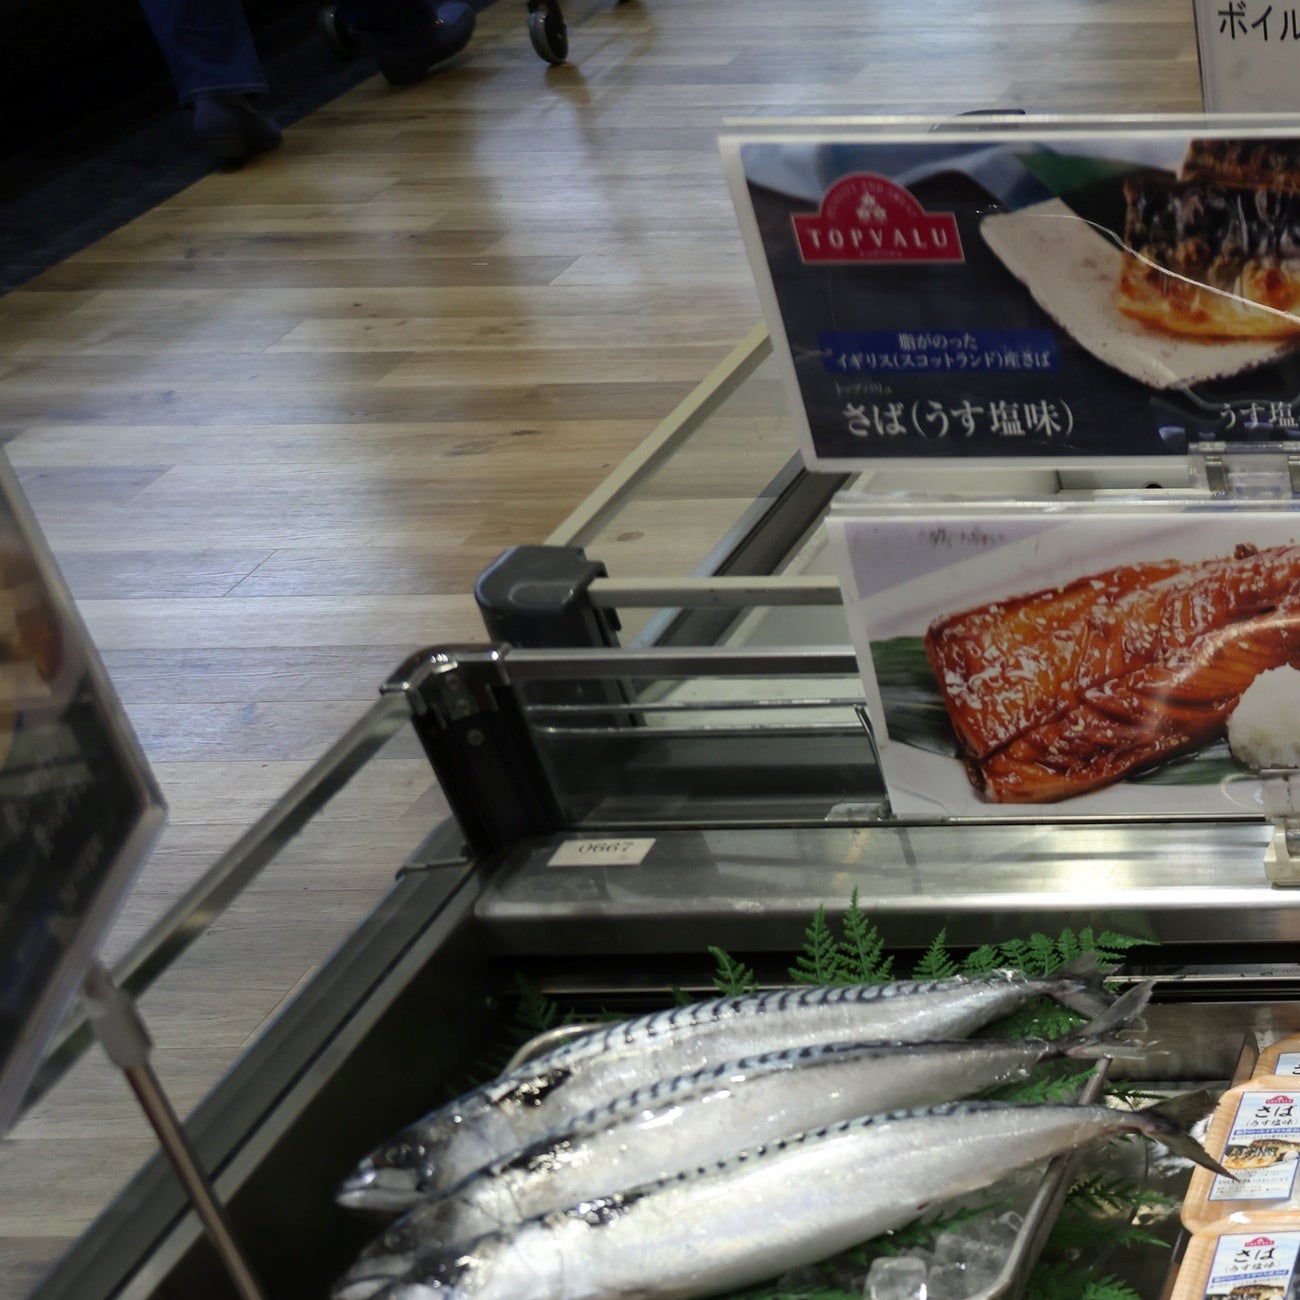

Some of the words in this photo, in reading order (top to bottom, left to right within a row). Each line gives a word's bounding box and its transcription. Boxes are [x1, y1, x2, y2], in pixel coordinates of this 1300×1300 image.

[807, 228, 948, 249] TOPVALU
[843, 399, 1073, 437] さば(うす塩味)
[1256, 1103, 1298, 1118] さば
[1233, 1246, 1276, 1263] さば
